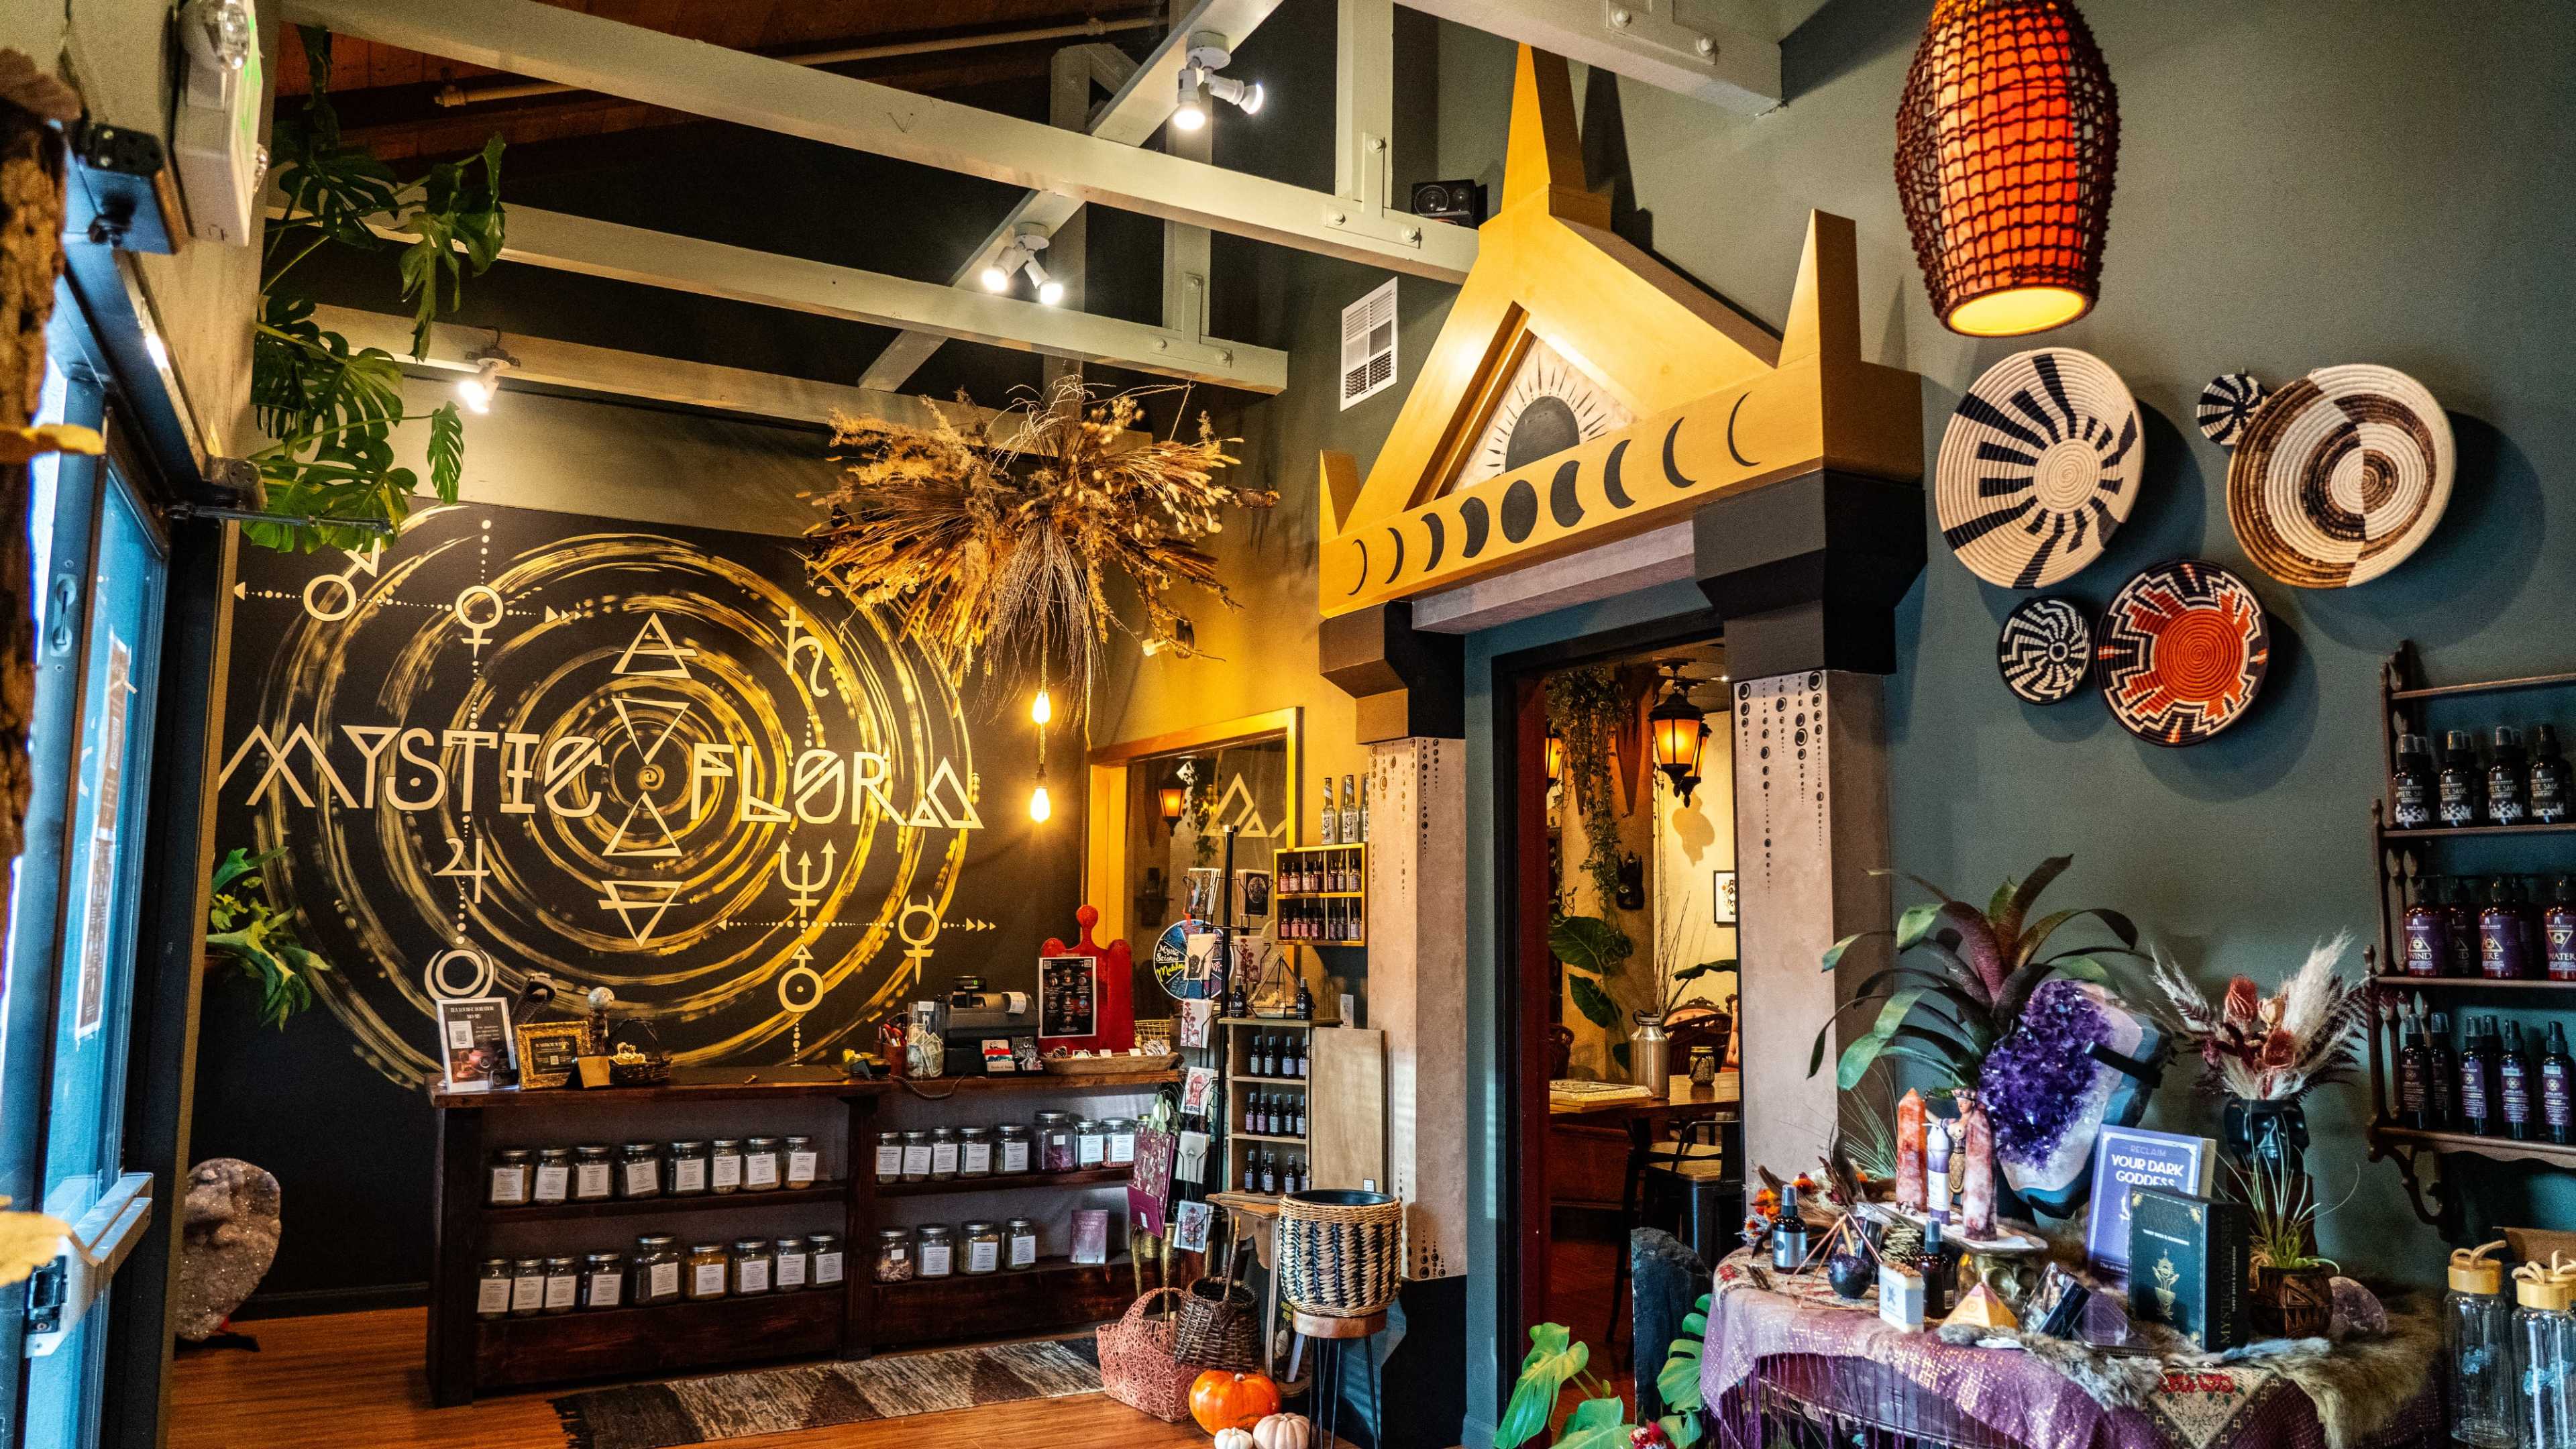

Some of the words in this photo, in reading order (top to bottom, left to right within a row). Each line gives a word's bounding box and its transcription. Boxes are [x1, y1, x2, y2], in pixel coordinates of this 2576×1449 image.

[218, 722, 603, 818] MYSTIC
[690, 741, 985, 829] FLORA
[2130, 1144, 2167, 1157] RECLAIM
[2111, 1153, 2145, 1171] YOUR
[2148, 1160, 2185, 1177] DARK
[2115, 1170, 2176, 1187] GODDESS
[2099, 1260, 2110, 1269] The
[2220, 1286, 2231, 1344] MYSTIC
